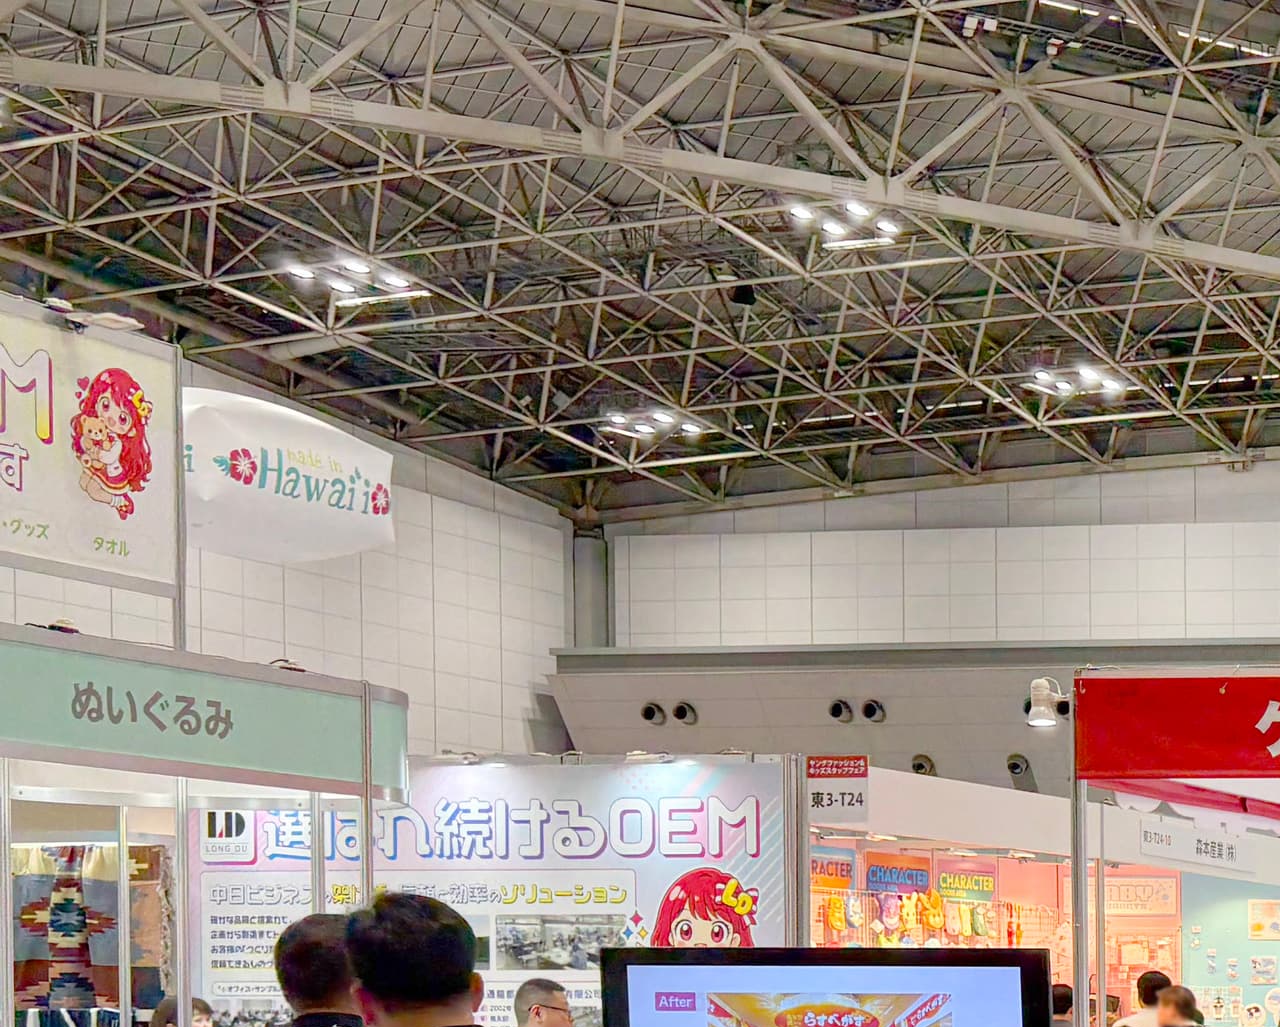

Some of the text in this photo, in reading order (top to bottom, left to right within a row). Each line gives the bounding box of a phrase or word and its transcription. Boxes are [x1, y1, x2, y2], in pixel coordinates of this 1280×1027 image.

[93, 536, 130, 557] タオル
[71, 682, 234, 739] ぬいぐるみ
[811, 792, 864, 808] 東3-T24
[205, 845, 231, 853] LONG
[812, 859, 852, 879] RACTER
[868, 865, 928, 886] CHARACTER
[939, 873, 994, 891] CHARACTER
[659, 994, 692, 1009] After
